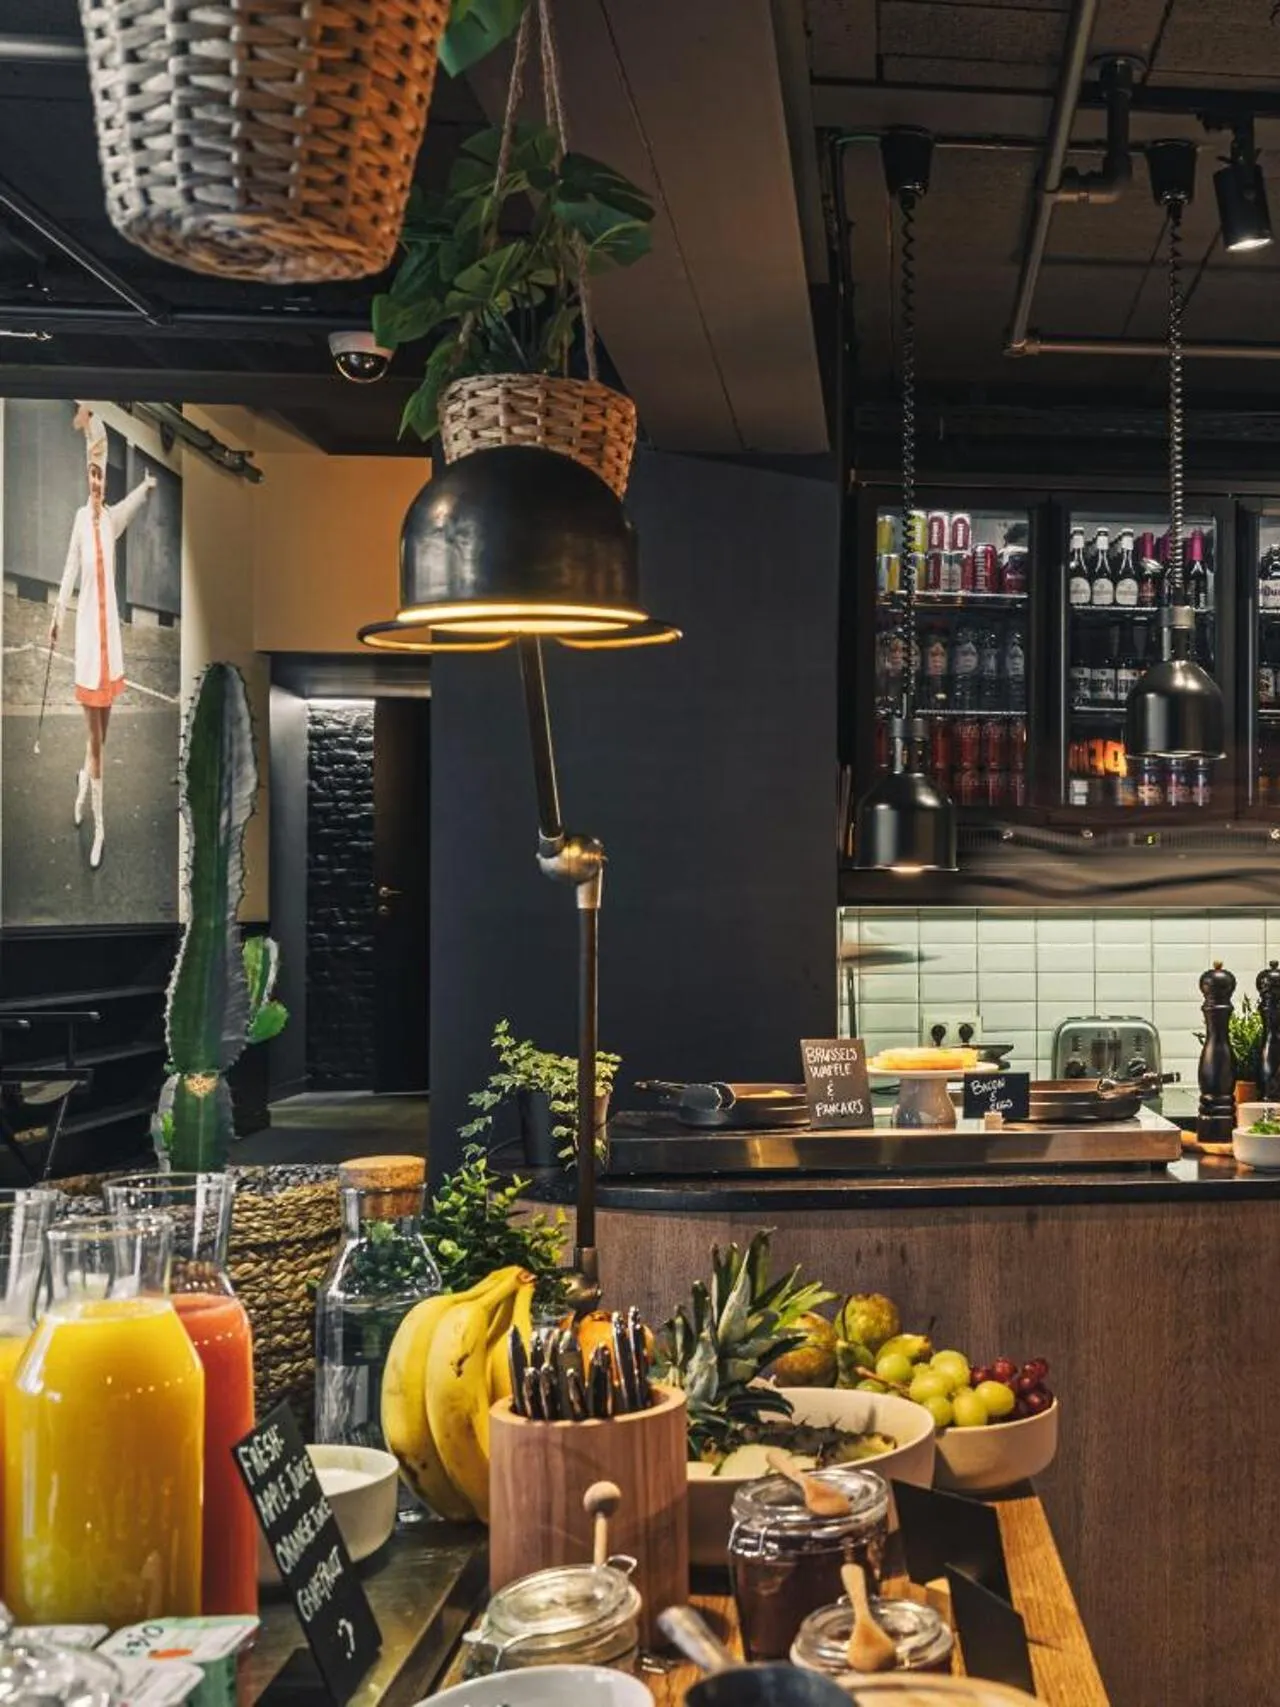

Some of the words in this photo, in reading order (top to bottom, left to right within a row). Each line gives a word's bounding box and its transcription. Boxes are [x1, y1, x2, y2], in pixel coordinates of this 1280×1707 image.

[805, 1046, 858, 1064] BRUSSELS
[808, 1062, 853, 1079] WAFFLE
[255, 1473, 292, 1529] APPLE
